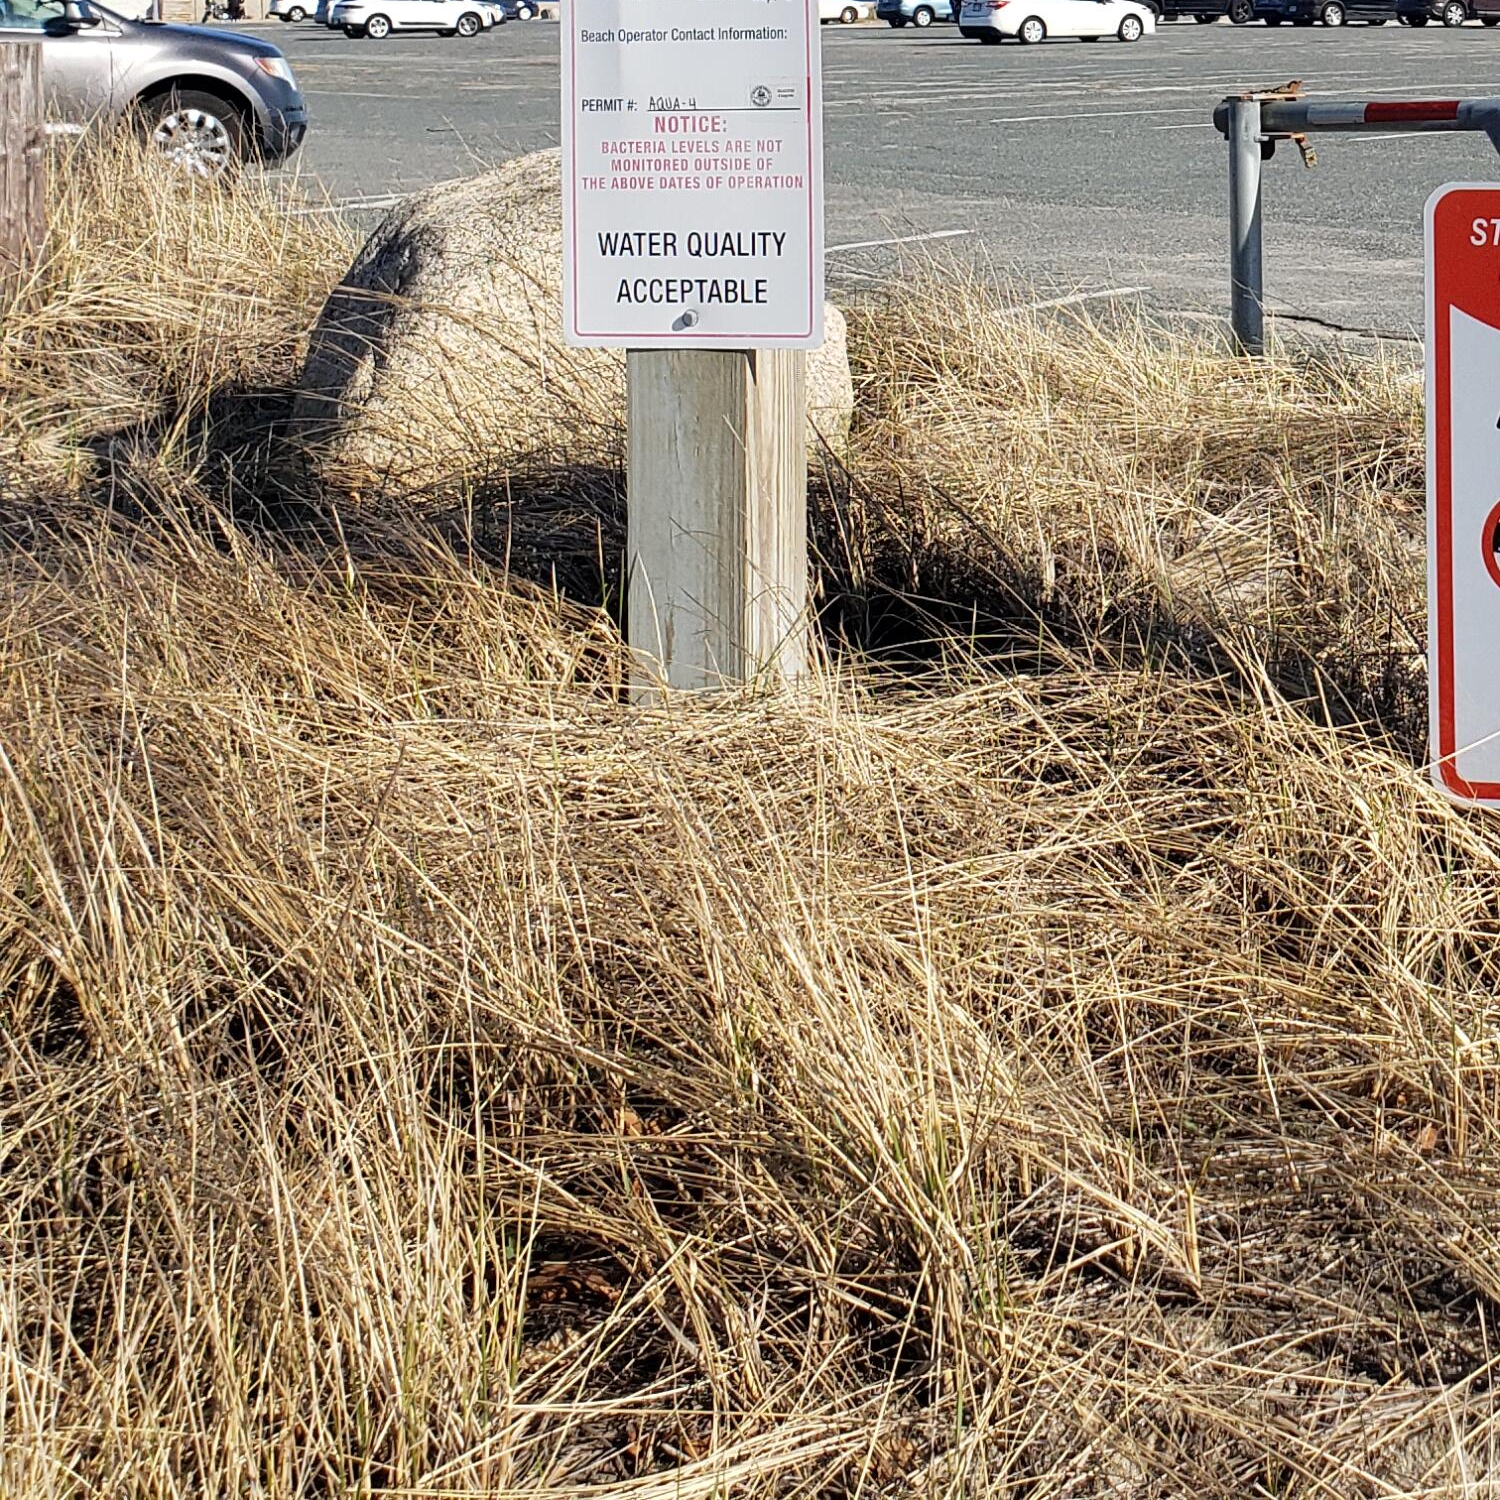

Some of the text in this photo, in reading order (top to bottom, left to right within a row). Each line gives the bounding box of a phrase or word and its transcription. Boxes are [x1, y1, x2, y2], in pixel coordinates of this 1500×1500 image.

[582, 27, 787, 44] Beach Operator Contact Information:
[582, 99, 623, 111] PERMIT
[655, 116, 726, 133] NOTICE:
[602, 140, 782, 154] BACTERIA LEVELS ARE NOT
[612, 158, 773, 171] MONITORED OUTSIDE OF
[582, 175, 803, 189] THE ABOVE DATES OF OPERATION
[598, 232, 786, 257] WATER QUALITY
[617, 279, 767, 303] ACCEPTABLE
